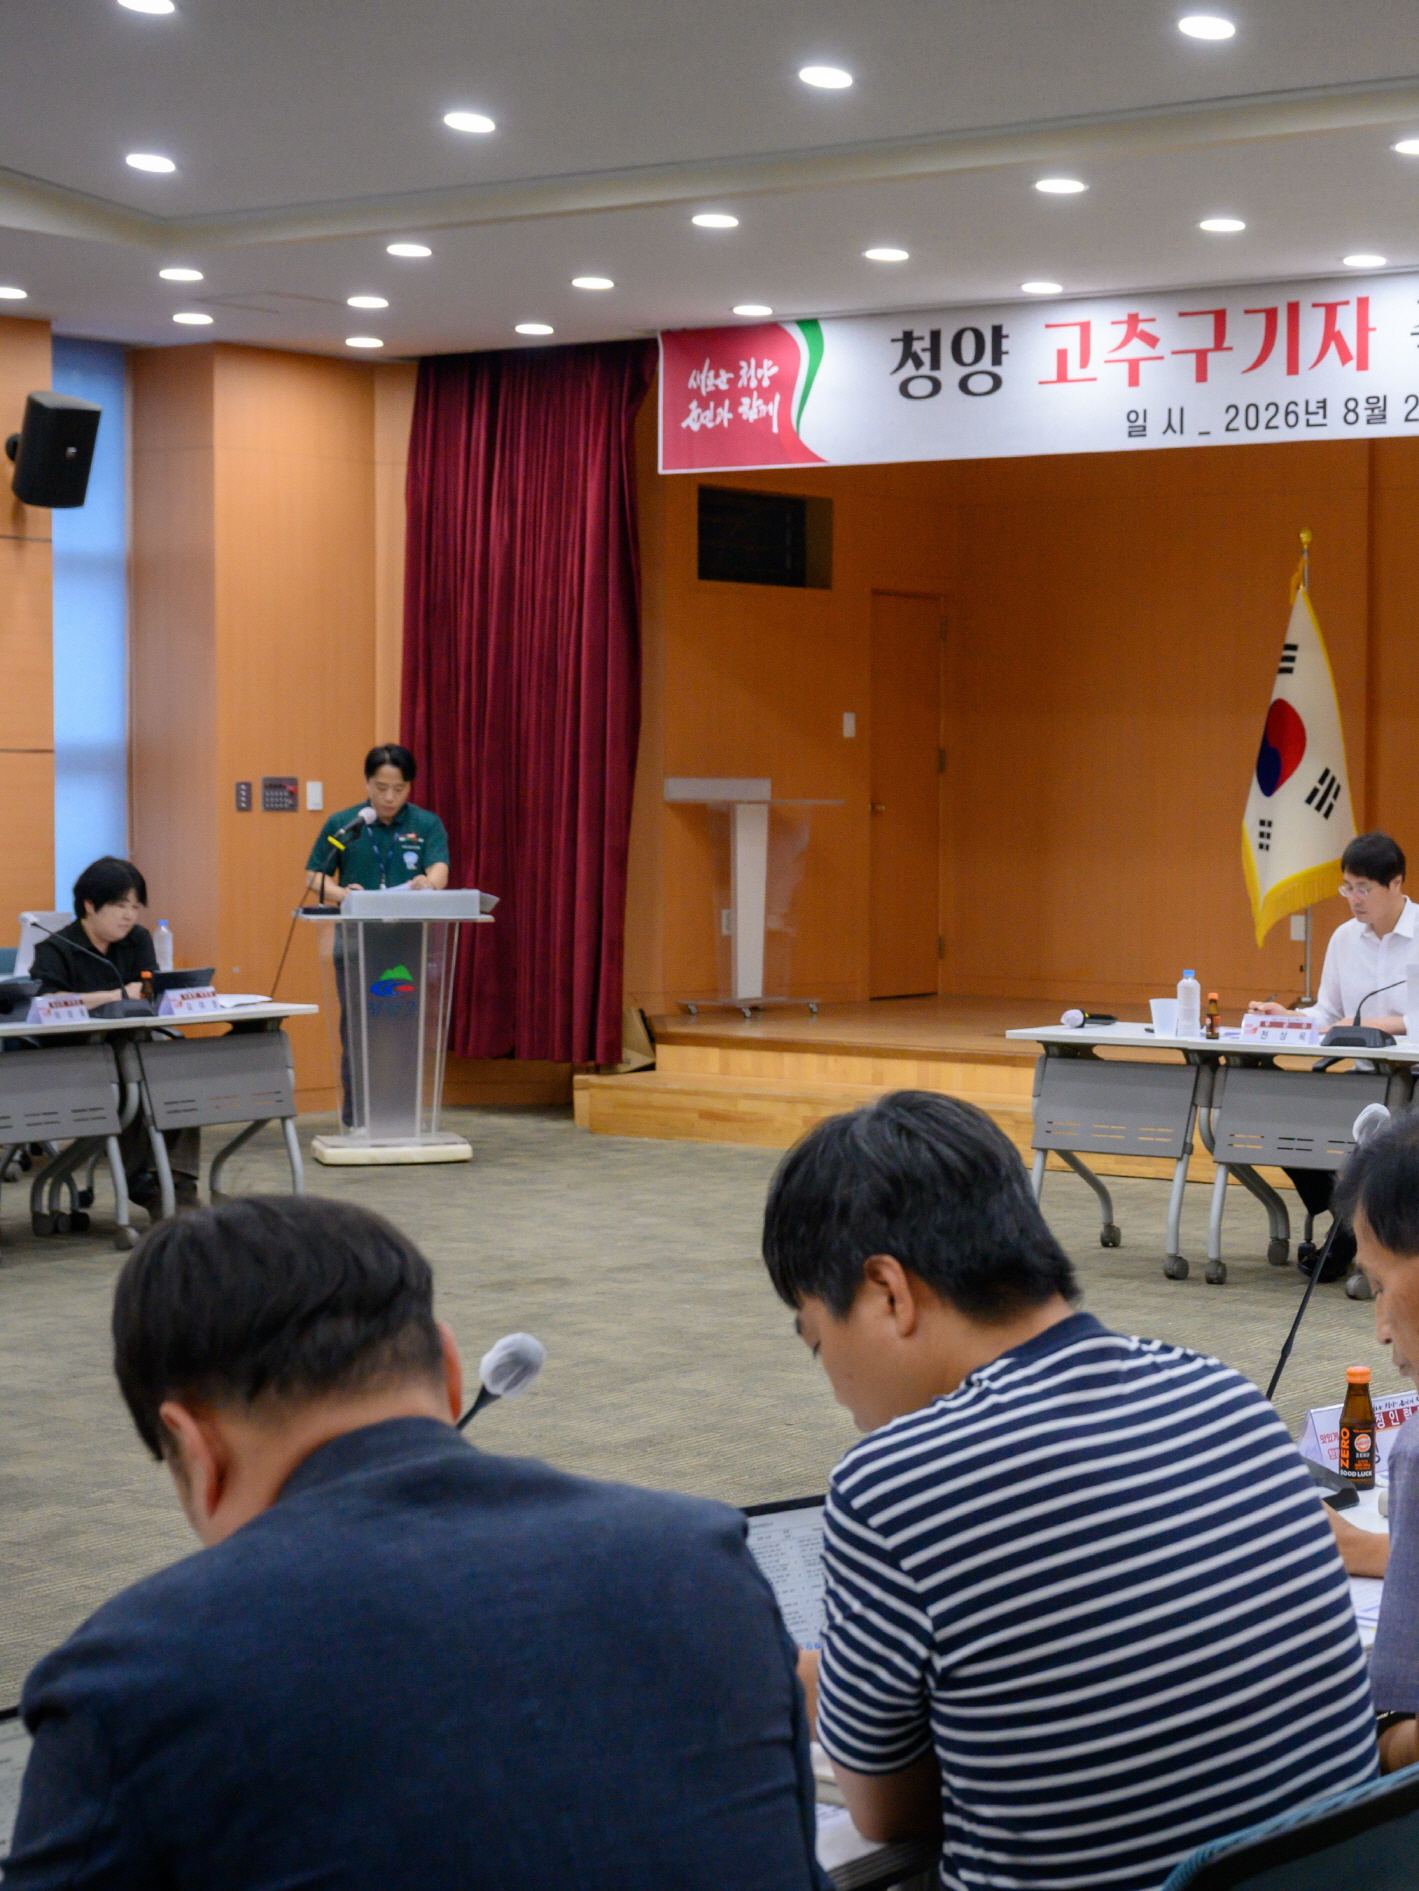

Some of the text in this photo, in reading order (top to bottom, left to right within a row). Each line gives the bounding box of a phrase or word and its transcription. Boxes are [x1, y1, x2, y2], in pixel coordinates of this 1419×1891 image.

[889, 324, 1010, 400] 청양
[1037, 296, 1378, 388] 고추구기자
[1224, 396, 1329, 432] 2026년
[1342, 393, 1388, 426] 8월
[1340, 1426, 1350, 1470] ZERO
[1357, 1470, 1373, 1478] LUCK
